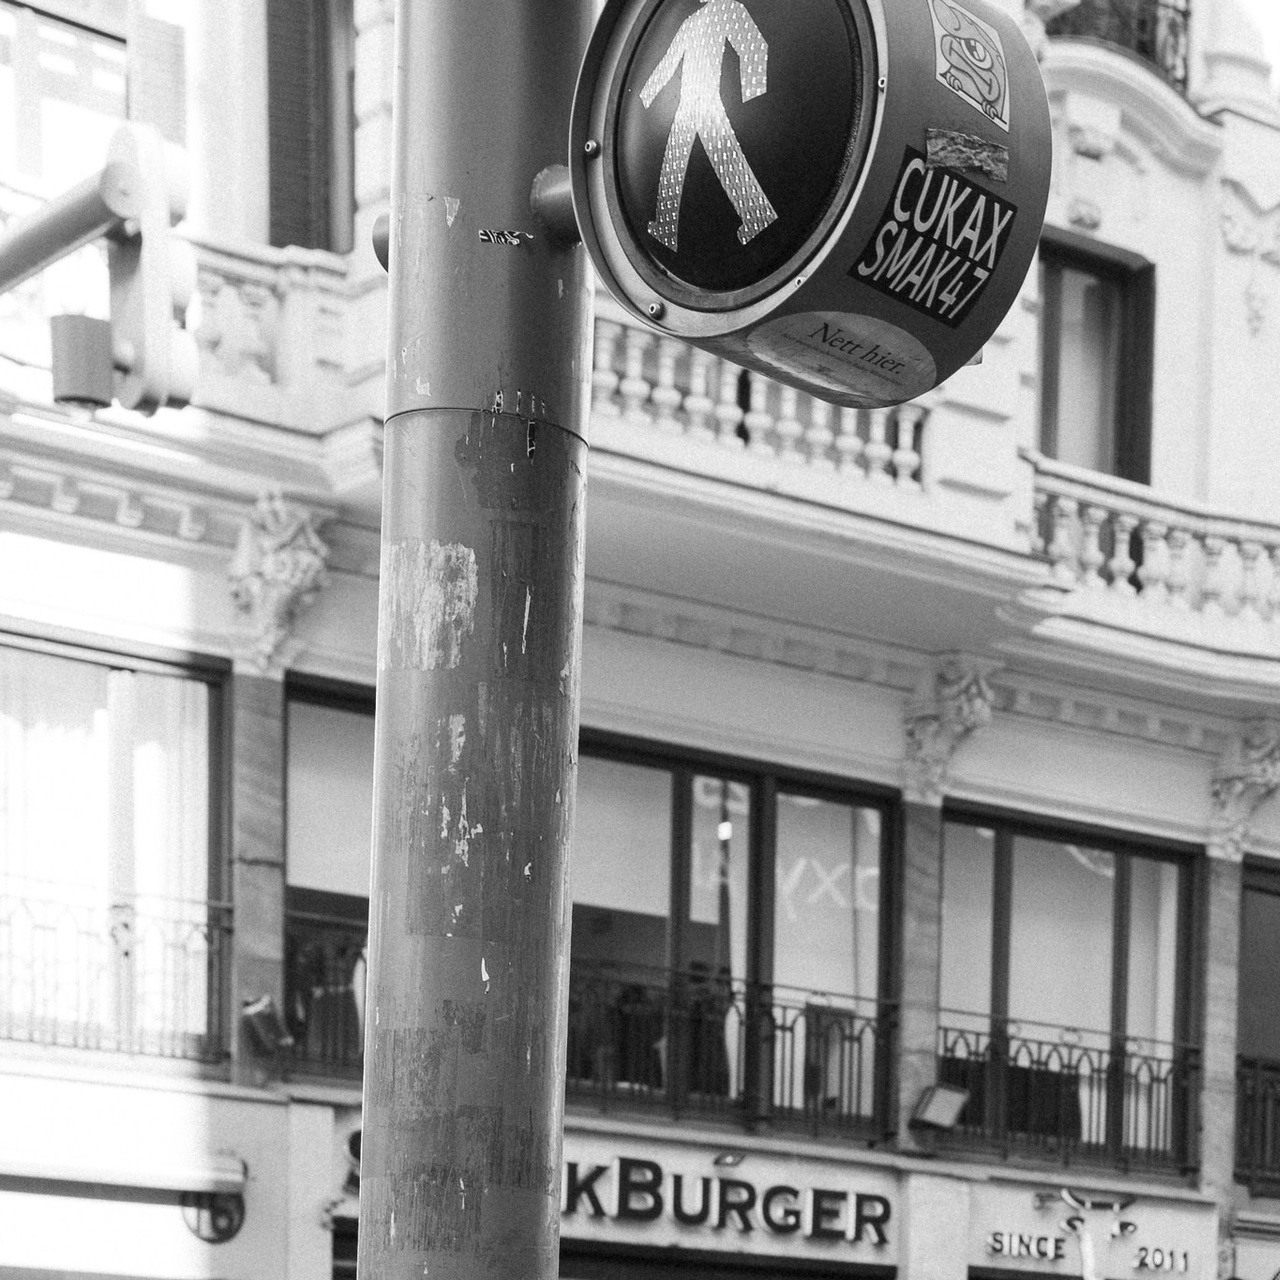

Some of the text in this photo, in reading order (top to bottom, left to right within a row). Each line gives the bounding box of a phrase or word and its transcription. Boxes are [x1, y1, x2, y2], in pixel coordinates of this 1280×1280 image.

[893, 157, 1014, 269] CUKAX
[857, 221, 990, 320] SMAK47
[807, 322, 864, 356] Nett
[859, 344, 906, 375] hier.
[564, 1157, 892, 1245] KBURGER
[989, 1232, 1188, 1273] SINCE 2011
